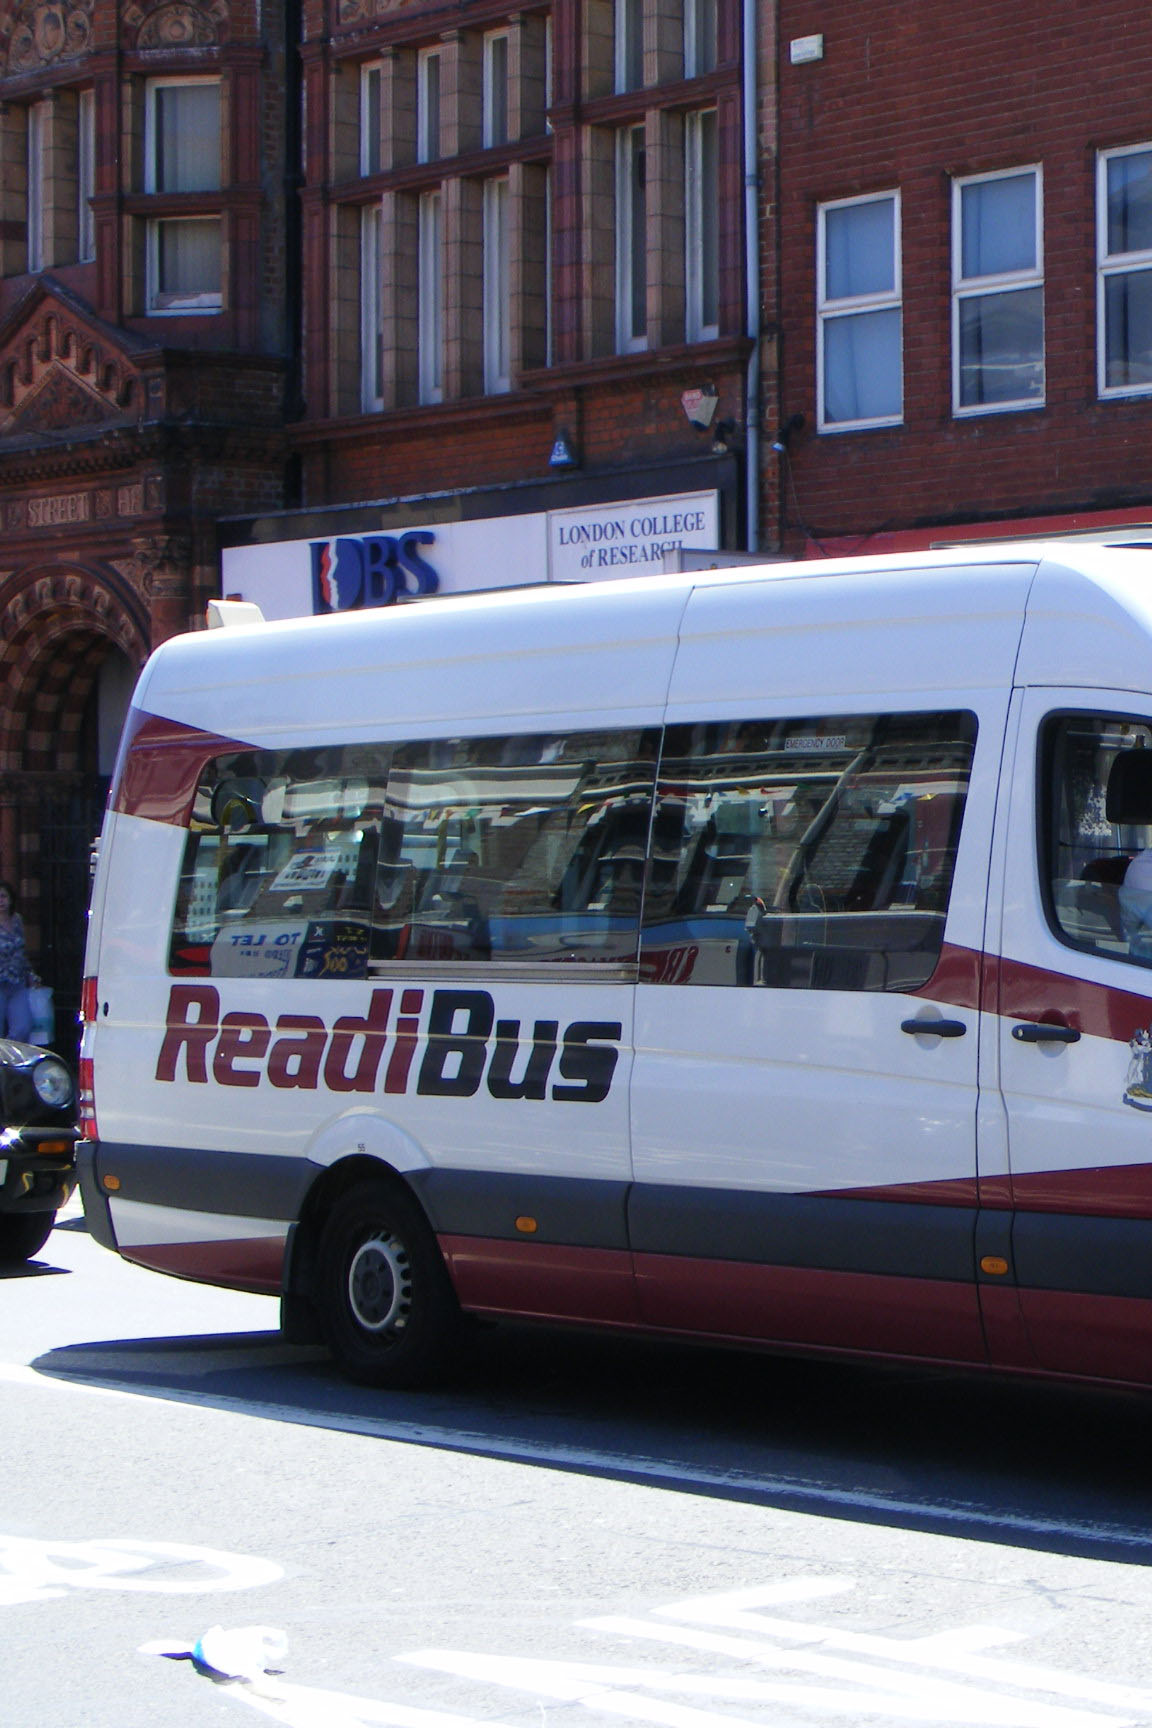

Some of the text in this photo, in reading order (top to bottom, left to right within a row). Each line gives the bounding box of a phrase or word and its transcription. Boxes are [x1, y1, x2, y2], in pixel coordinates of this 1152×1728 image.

[559, 511, 706, 546] LONDON COLLEGE
[580, 548, 597, 569] of
[155, 983, 623, 1103] ReadiBus
